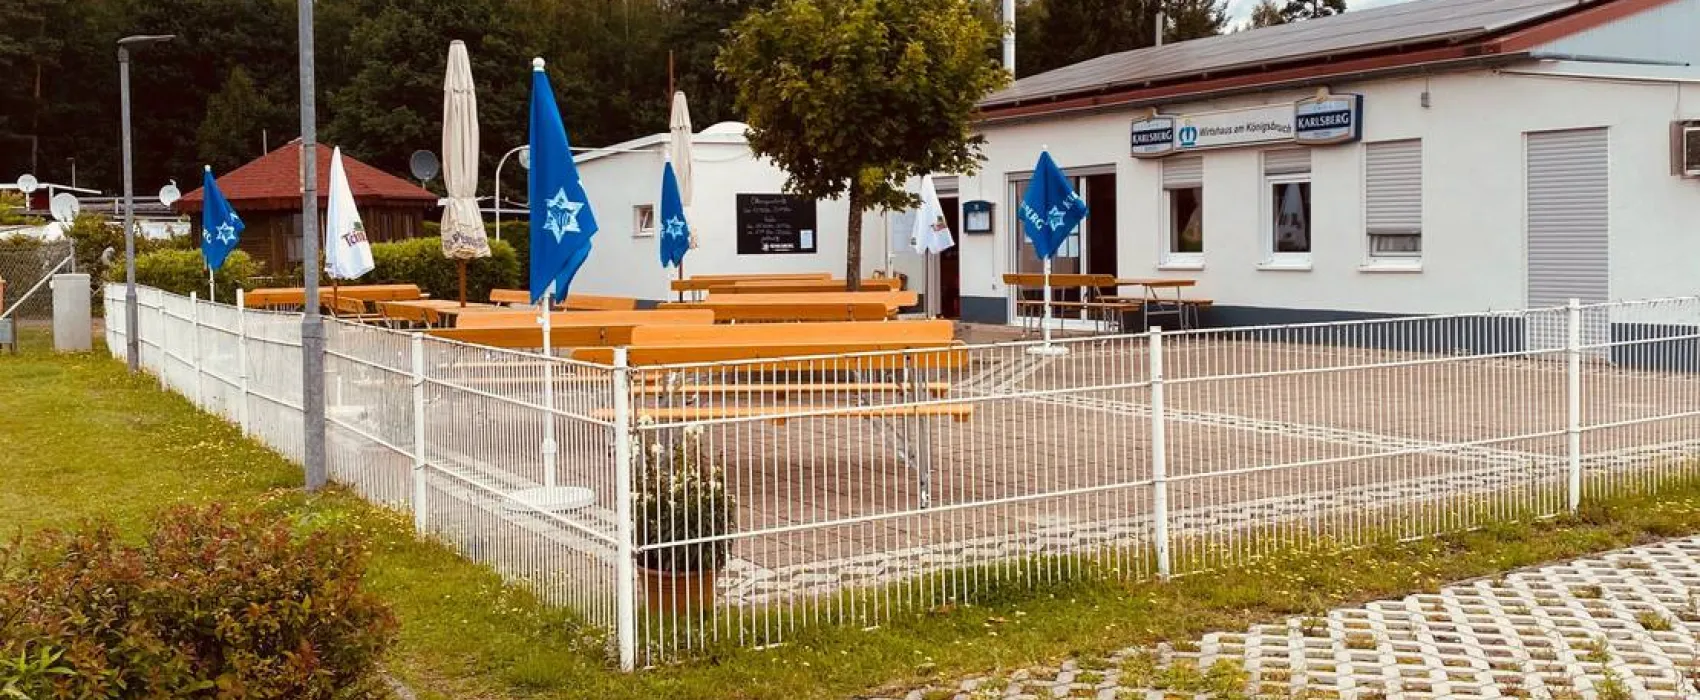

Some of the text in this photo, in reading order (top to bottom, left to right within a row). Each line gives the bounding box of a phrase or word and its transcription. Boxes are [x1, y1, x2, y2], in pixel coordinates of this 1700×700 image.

[1298, 112, 1349, 129] KARLSBERG
[1132, 130, 1172, 144] KARLSBERG
[1200, 126, 1232, 137] Wirtshaus
[1234, 125, 1244, 133] am
